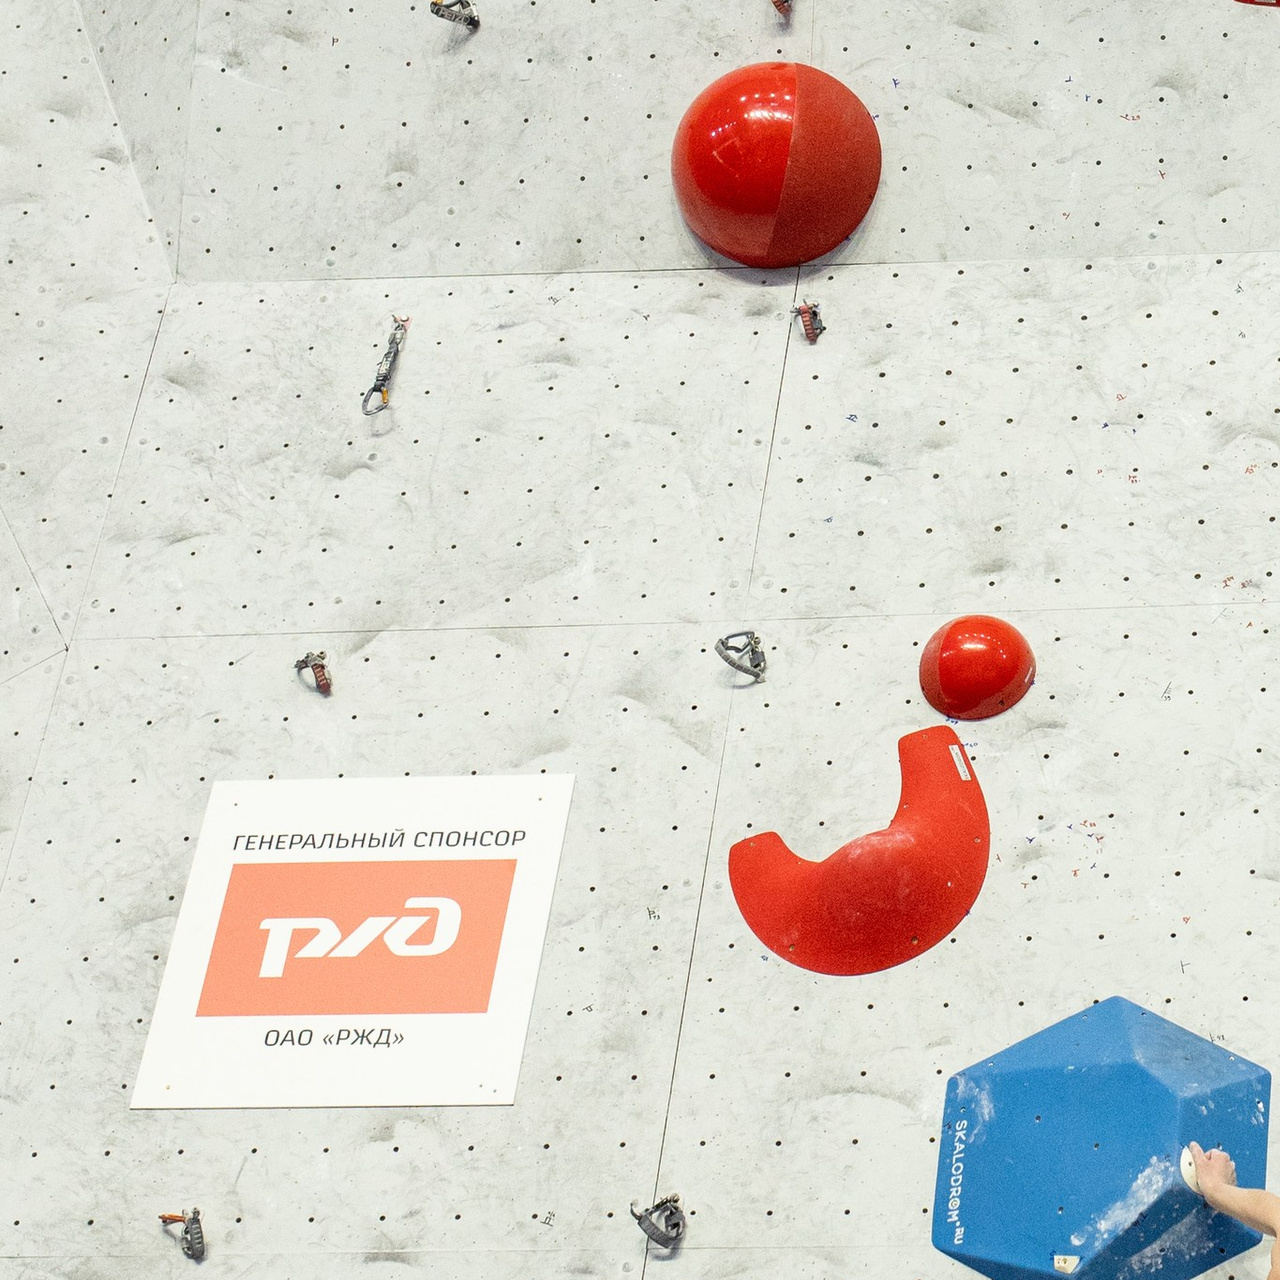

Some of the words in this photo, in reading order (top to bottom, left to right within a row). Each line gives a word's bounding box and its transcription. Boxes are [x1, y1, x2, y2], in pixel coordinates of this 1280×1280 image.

[232, 828, 406, 851] ГЕНЕРАЛЬНЫЙ
[413, 829, 527, 849] СПОНСОР
[264, 1028, 313, 1047] ОАО
[322, 1028, 405, 1048] «РЖД»
